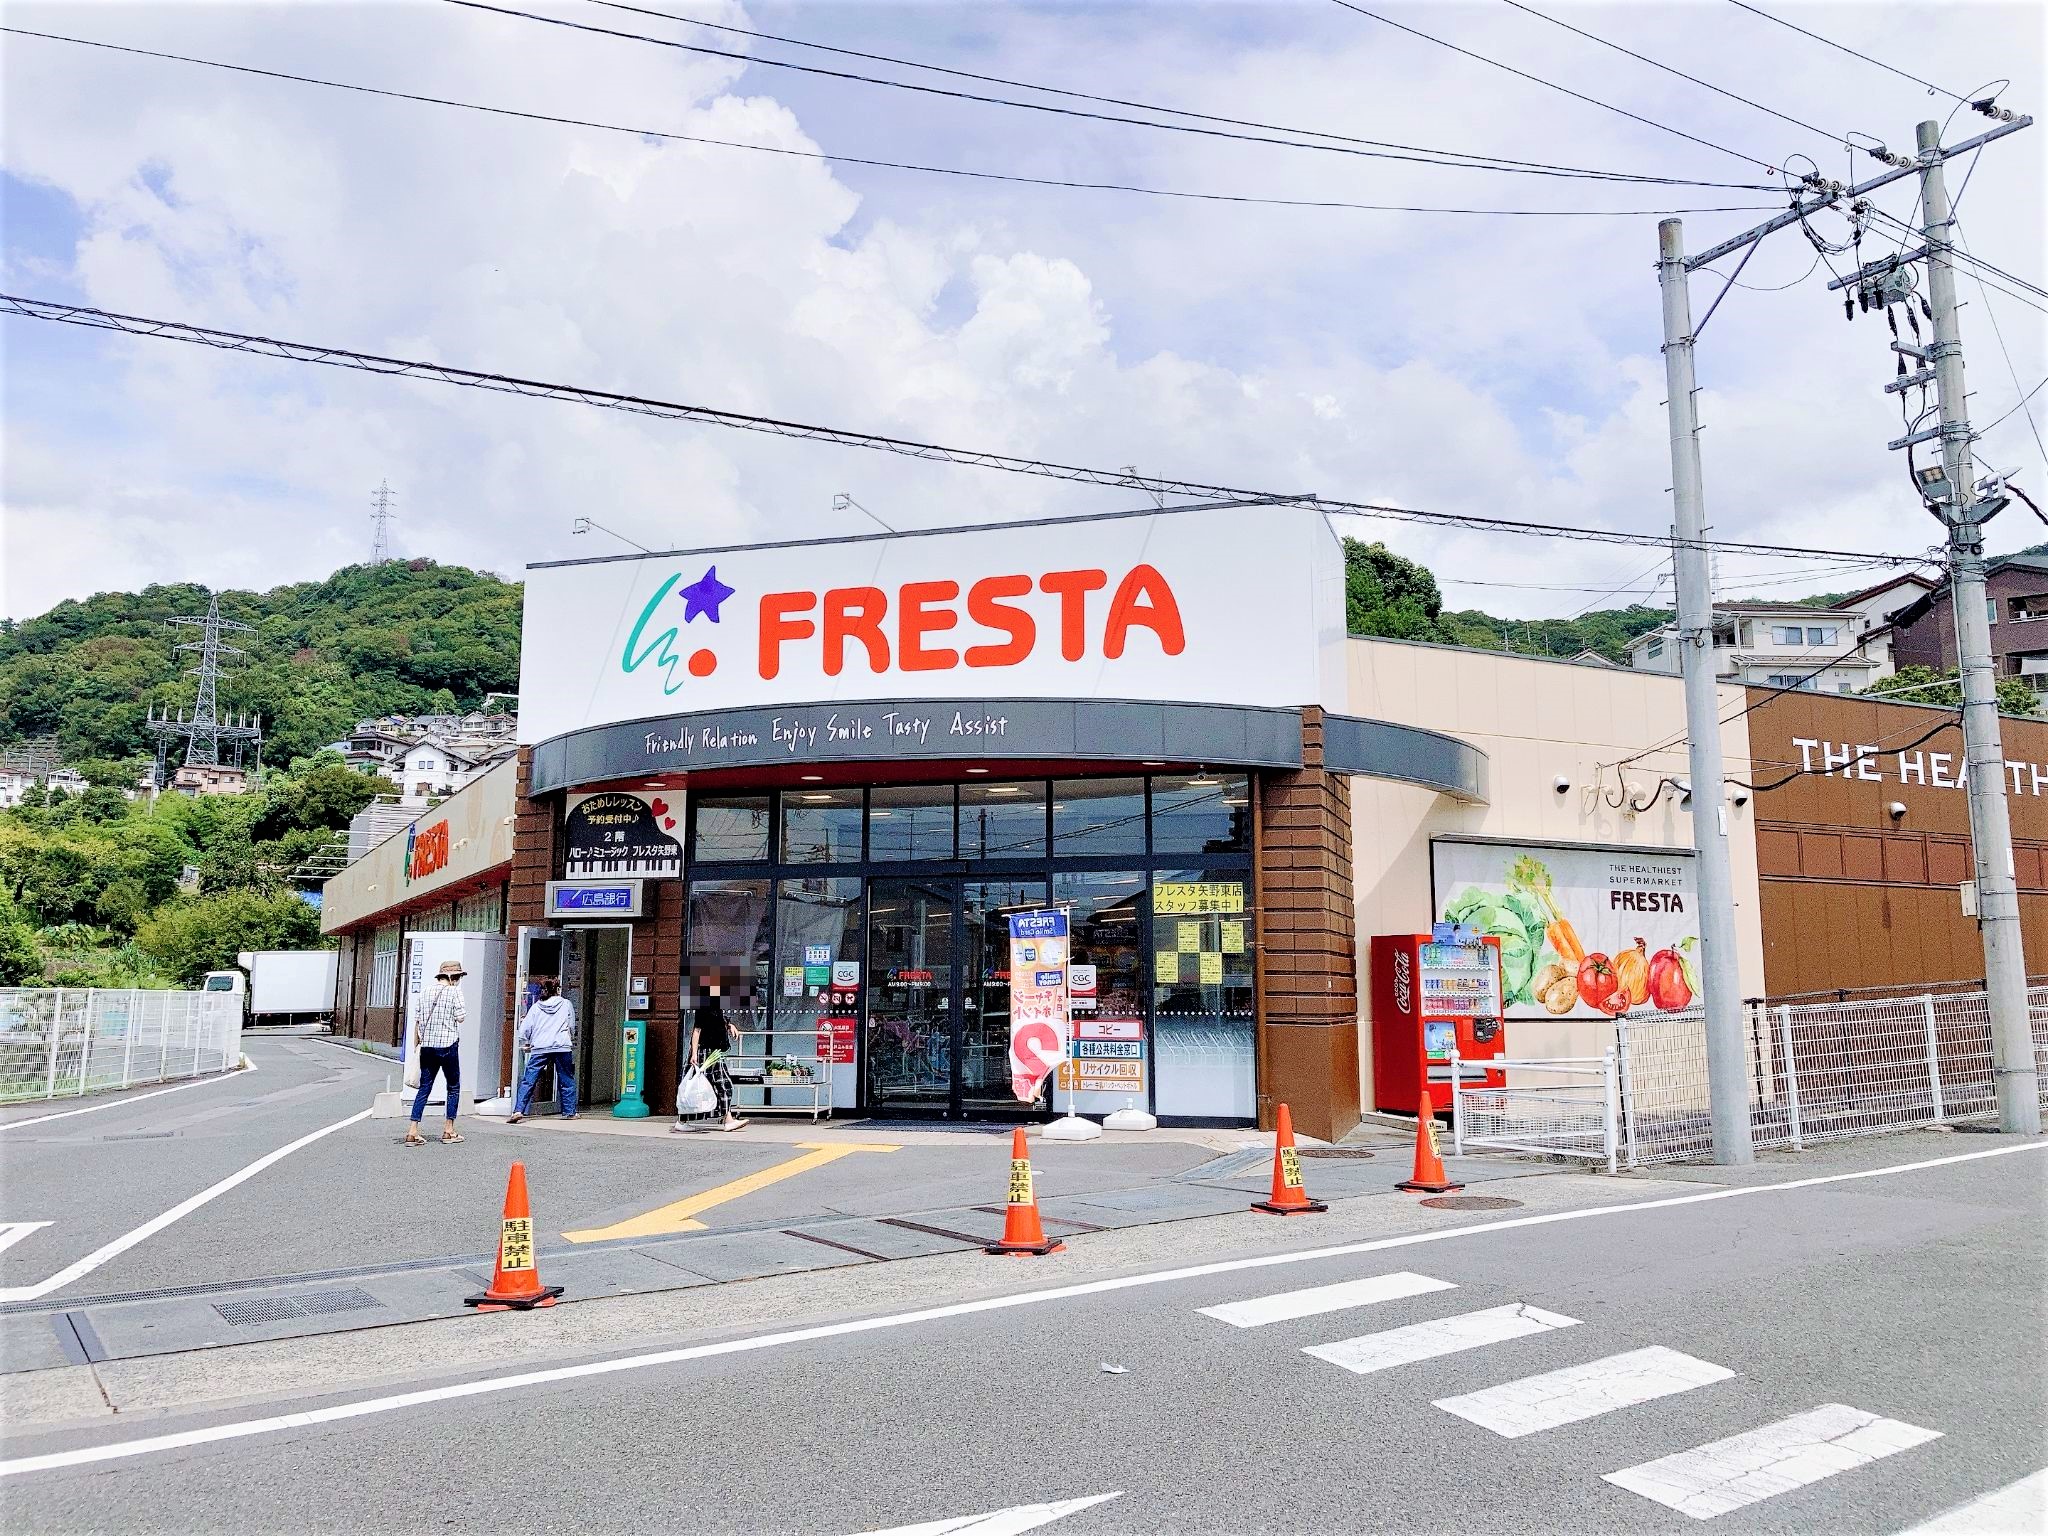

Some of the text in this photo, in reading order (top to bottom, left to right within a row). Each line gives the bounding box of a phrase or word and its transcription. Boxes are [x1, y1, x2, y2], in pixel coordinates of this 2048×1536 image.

[759, 564, 1186, 680] FRESTA
[645, 711, 1009, 755] Friendly Relation Enjoy Smile Tasty Assist
[1792, 737, 1882, 782] THE
[581, 795, 643, 815] おためしレッスン
[1609, 864, 1682, 875] THE HEALTHIEST
[1609, 875, 1682, 886] SUPERMARKET
[1154, 884, 1242, 896] フレスタ矢野東店
[581, 892, 628, 906] 広島銀行
[1610, 890, 1684, 913] FRESTA
[837, 970, 854, 978] CGC
[1099, 1023, 1121, 1035] コピー
[1082, 1043, 1138, 1056] 各種公共料金窓口
[1083, 1062, 1136, 1076] リサイクル回収
[1008, 1161, 1030, 1203] 駐車禁止
[503, 1220, 531, 1270] 駐車禁止
